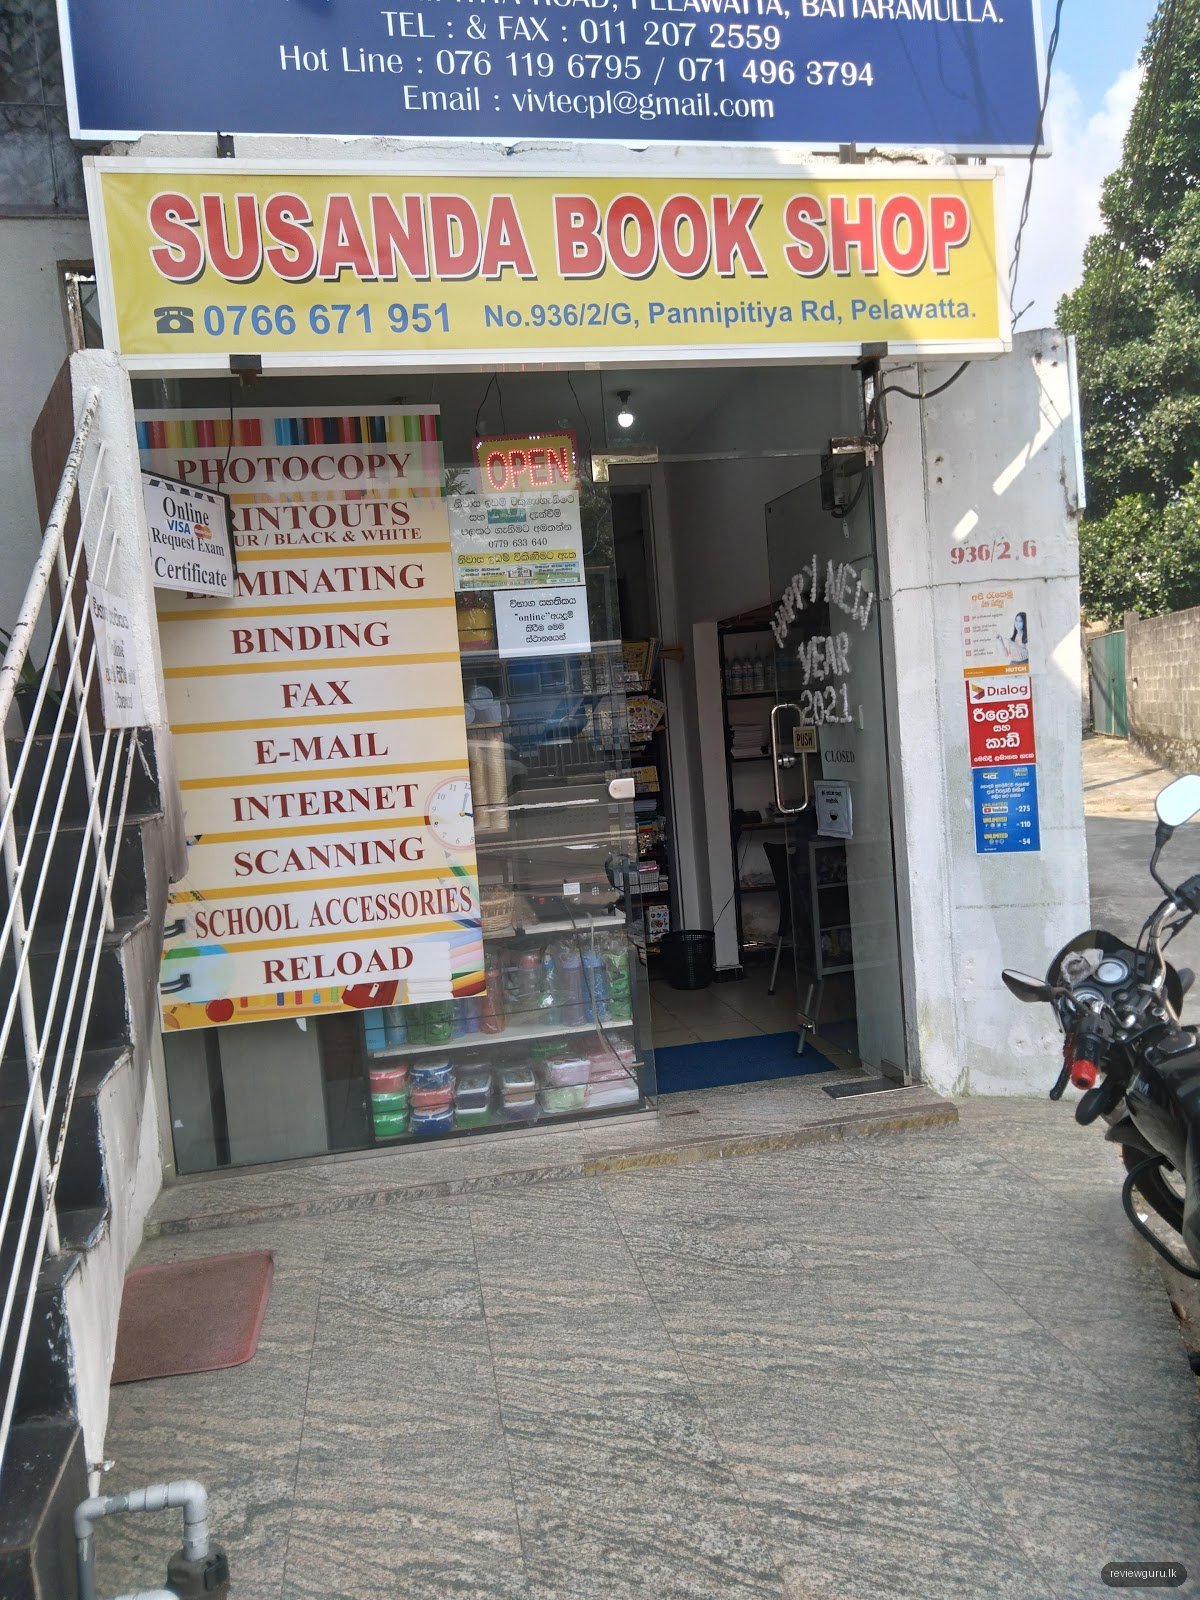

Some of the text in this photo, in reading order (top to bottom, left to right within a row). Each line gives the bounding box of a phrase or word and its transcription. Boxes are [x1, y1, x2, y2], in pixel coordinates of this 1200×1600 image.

[381, 11, 436, 39] TEL
[466, 15, 487, 40] &
[498, 16, 549, 41] FAX
[581, 19, 627, 44] 011
[644, 22, 696, 46] 207
[709, 25, 780, 50] 2559
[279, 45, 329, 73] Hot
[342, 47, 403, 74] Line
[436, 49, 491, 76] 076
[505, 52, 554, 78] 119
[567, 53, 641, 80] 6795
[678, 57, 726, 83] 071
[742, 60, 795, 85] 496
[806, 61, 874, 87] 3794
[403, 85, 480, 112] Email
[512, 88, 775, 121] vivtecpl@gmail.com
[148, 190, 970, 283] SUSANDA BOOK SHOP
[203, 298, 976, 336] 0766 671 951 No.936/2/G, Pannipitiya Rd, Pelawatta.
[175, 453, 412, 485] PHOTOCOPY
[487, 448, 569, 490] OPEN
[163, 496, 210, 525] Online
[167, 519, 191, 535] VISA
[230, 501, 411, 531] INTOUTS
[151, 527, 195, 550] Request
[198, 537, 225, 556] Exam
[274, 531, 336, 545] BLACK
[342, 530, 356, 542] &
[361, 527, 422, 541] WHITE
[488, 538, 548, 549] 0779 633 640
[155, 556, 228, 587] Certificate
[185, 563, 426, 599] MINATING
[824, 558, 874, 631] NEW
[231, 621, 391, 655] BINDING
[798, 631, 850, 685] YEAR
[280, 680, 353, 709] FAX
[800, 683, 852, 726] 2021
[987, 684, 1028, 697] Dialog
[796, 733, 813, 747] PUSH
[993, 724, 1011, 732] සහ
[254, 732, 389, 765] E-MAIL
[825, 751, 856, 763] CLOSED
[230, 784, 419, 822] INTERNET
[234, 836, 427, 878] SCANNING
[195, 885, 473, 939] SCHOOL ACCESSORIES
[262, 946, 414, 984] RELOAD
